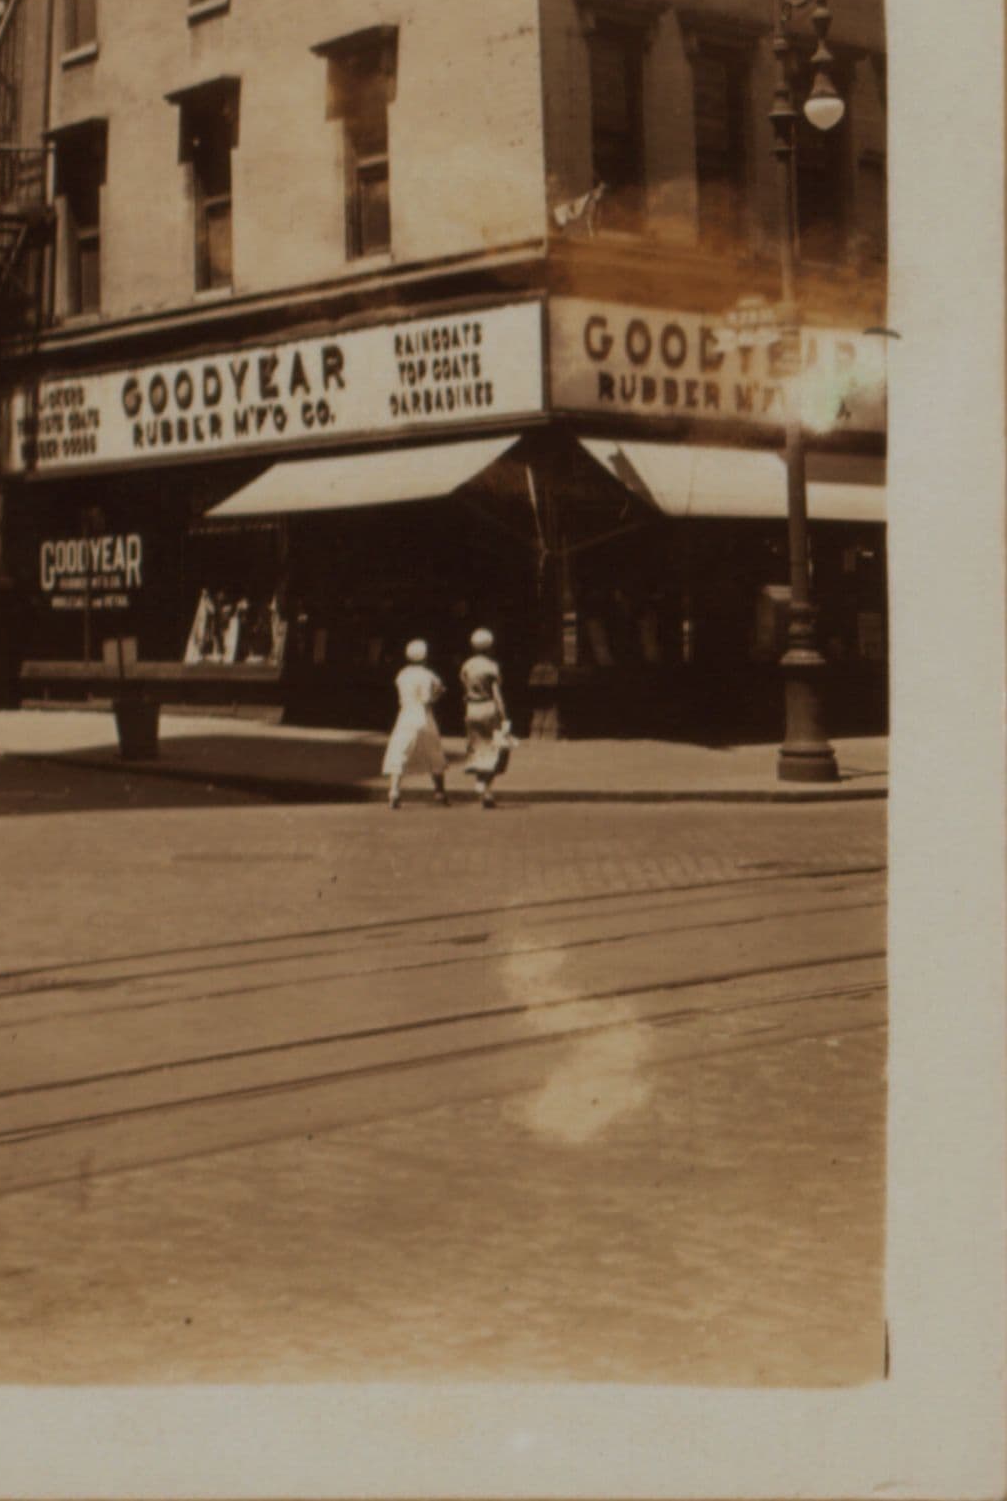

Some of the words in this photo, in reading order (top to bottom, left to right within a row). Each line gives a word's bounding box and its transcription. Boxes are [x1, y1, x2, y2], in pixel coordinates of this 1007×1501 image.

[394, 322, 482, 357] RAINCOATS
[121, 344, 346, 419] GOODYEAR
[398, 359, 427, 388] TOP
[432, 353, 481, 382] COATS
[597, 370, 721, 412] RUBBER
[132, 412, 222, 449] RUBBER
[301, 398, 337, 430] CO.
[39, 533, 142, 592] GOODYEAR
